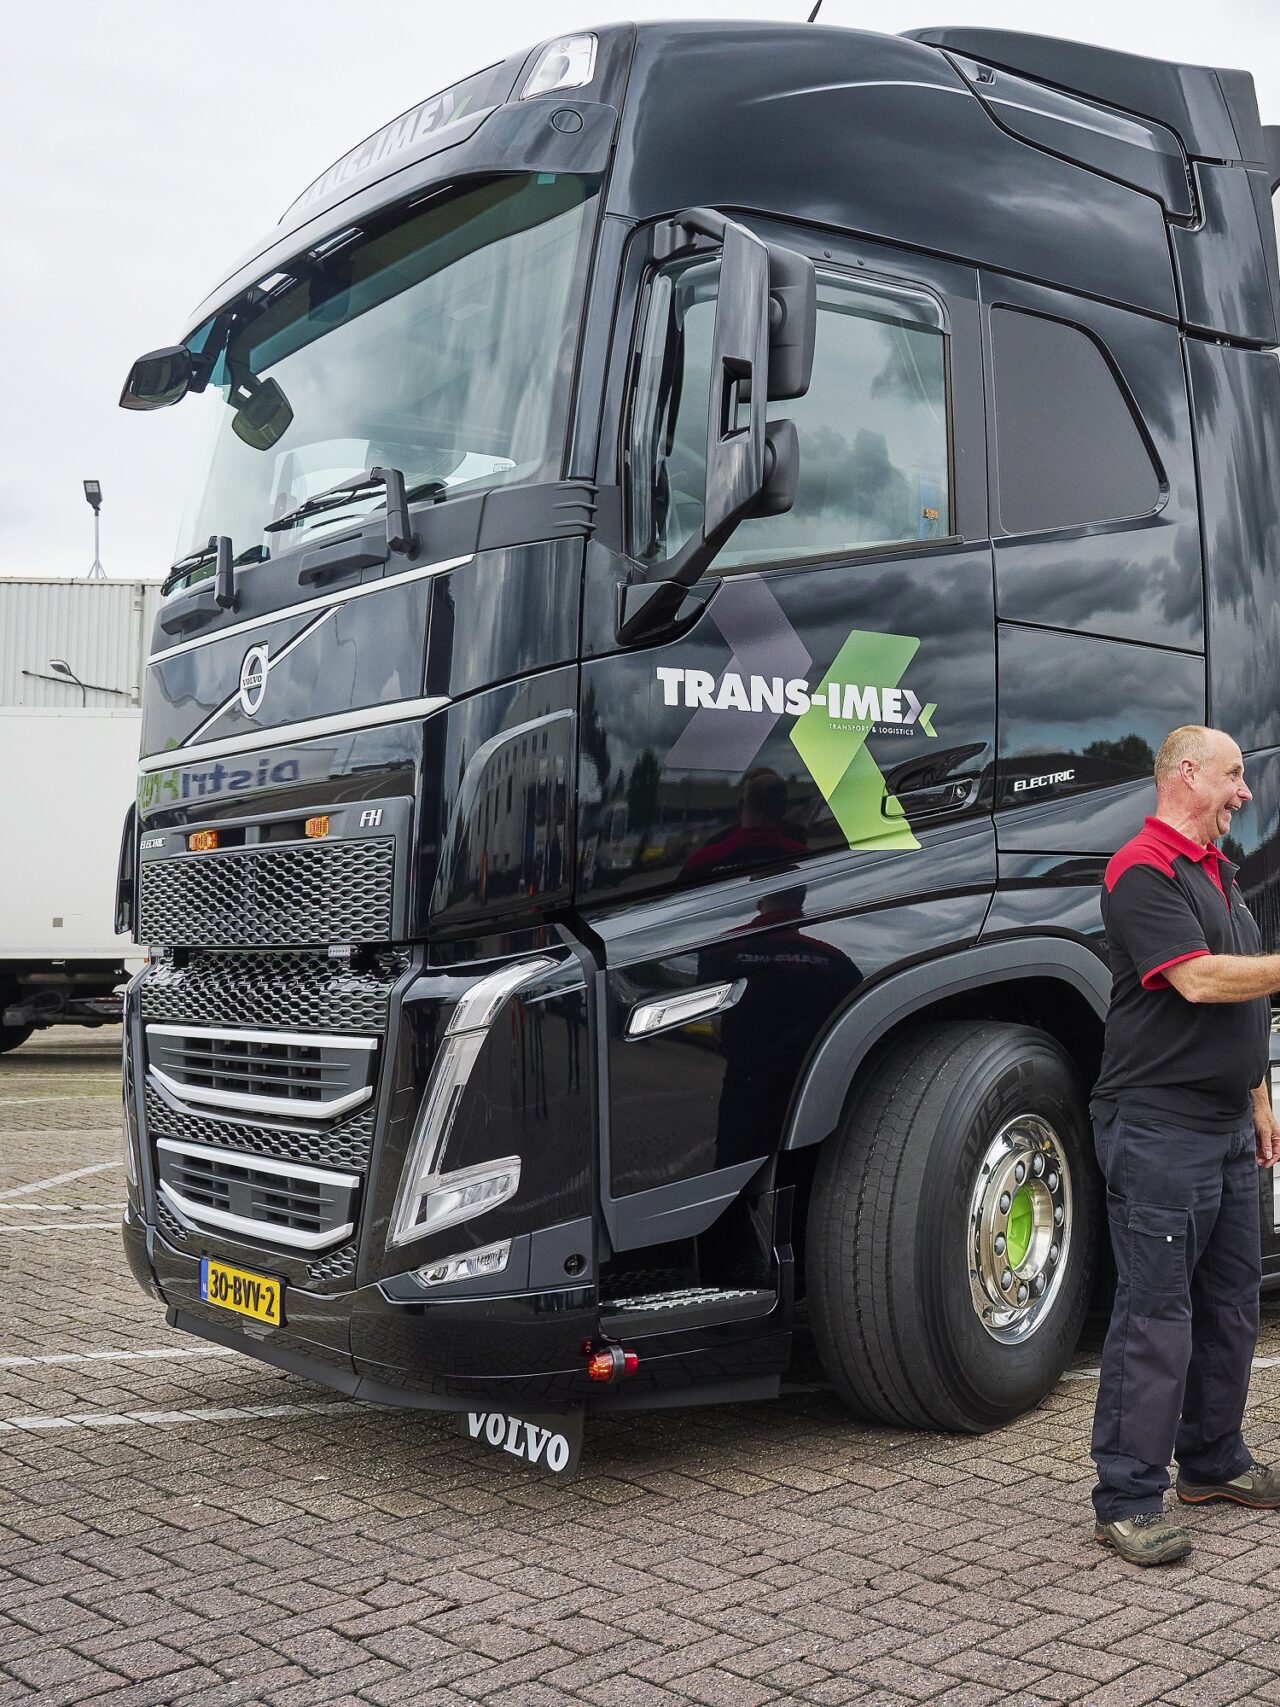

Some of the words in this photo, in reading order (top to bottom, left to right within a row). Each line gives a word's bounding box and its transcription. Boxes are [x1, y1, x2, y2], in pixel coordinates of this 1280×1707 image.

[242, 675, 263, 687] VOLVO
[656, 666, 938, 738] TRANS-IMEX
[829, 723, 869, 732] TRANSPORT
[879, 727, 914, 736] LOGISTICS
[1014, 769, 1075, 792] ELECTRIC
[360, 809, 382, 827] FH
[140, 837, 166, 850] ELECTRIC
[210, 1269, 275, 1318] 30-BVV-2
[468, 1412, 569, 1472] VOLVO
